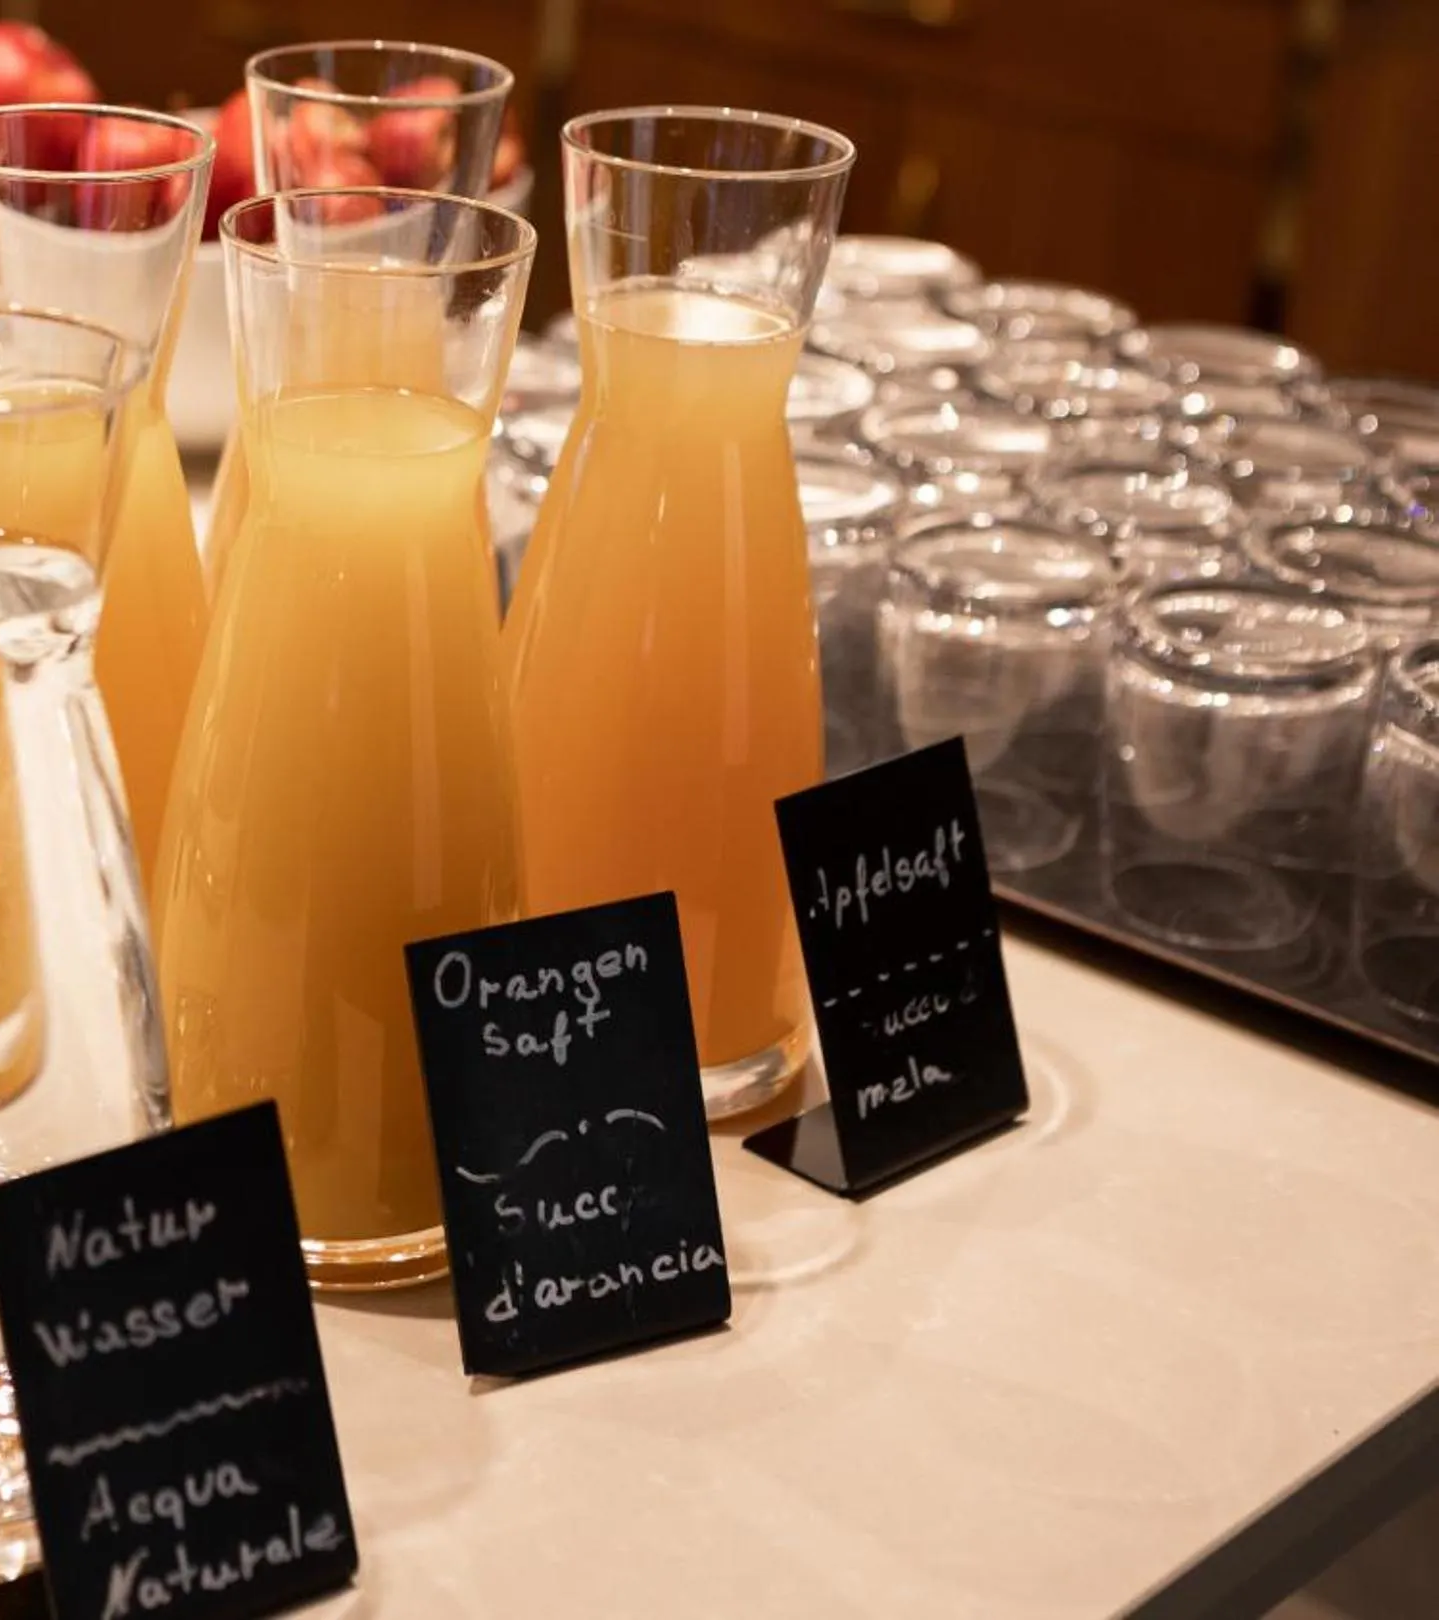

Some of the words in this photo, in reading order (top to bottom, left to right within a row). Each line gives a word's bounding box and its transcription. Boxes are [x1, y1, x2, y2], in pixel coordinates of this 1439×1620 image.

[433, 942, 649, 1009] Orangen
[860, 992, 952, 1037] ucco
[46, 1195, 218, 1278] Natur
[493, 1184, 630, 1234] Succ
[34, 1278, 252, 1369] Wasser
[80, 1461, 261, 1542] Acqua
[100, 1502, 346, 1620] Naturale
